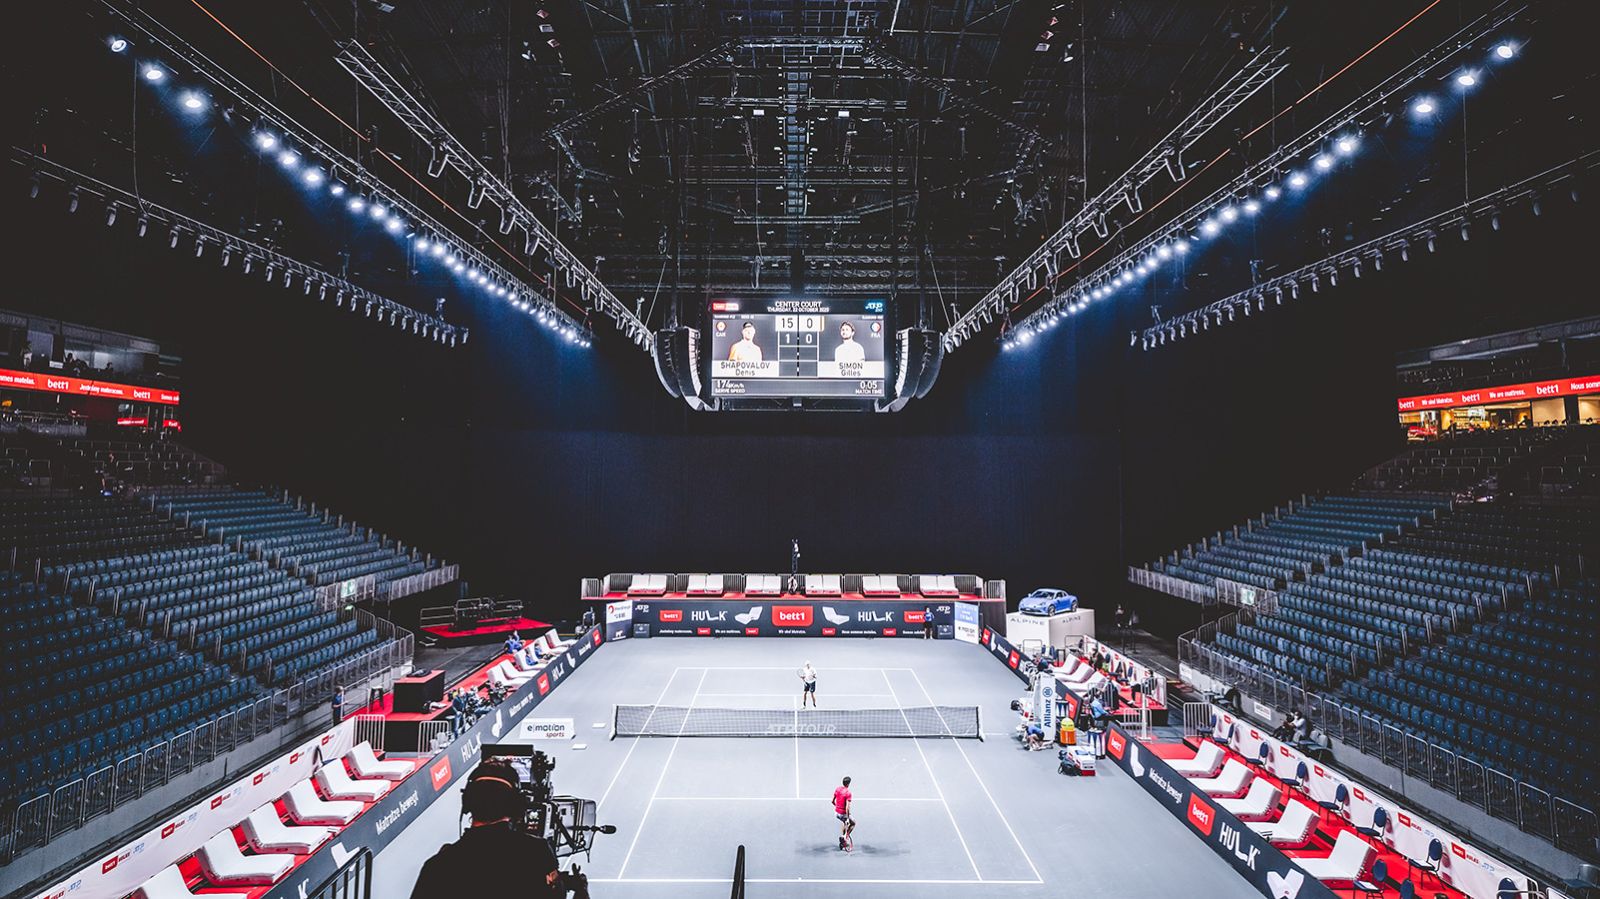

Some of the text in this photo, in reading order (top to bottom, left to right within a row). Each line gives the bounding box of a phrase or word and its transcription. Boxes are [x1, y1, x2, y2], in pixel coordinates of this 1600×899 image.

[782, 318, 794, 328] 15
[806, 318, 812, 328] 0
[786, 334, 790, 344] 1
[806, 334, 812, 344] 0
[48, 379, 68, 390] bett1
[1536, 384, 1559, 394] bett1
[134, 390, 150, 399] bett1
[1462, 394, 1480, 402] bett1
[1399, 400, 1414, 408] bett1
[692, 610, 728, 621] HULK
[780, 612, 805, 620] bett1
[858, 611, 894, 621] HULK
[376, 790, 419, 835] Matratze bewegt
[1192, 803, 1208, 825] bett1
[1219, 822, 1258, 871] HULK
